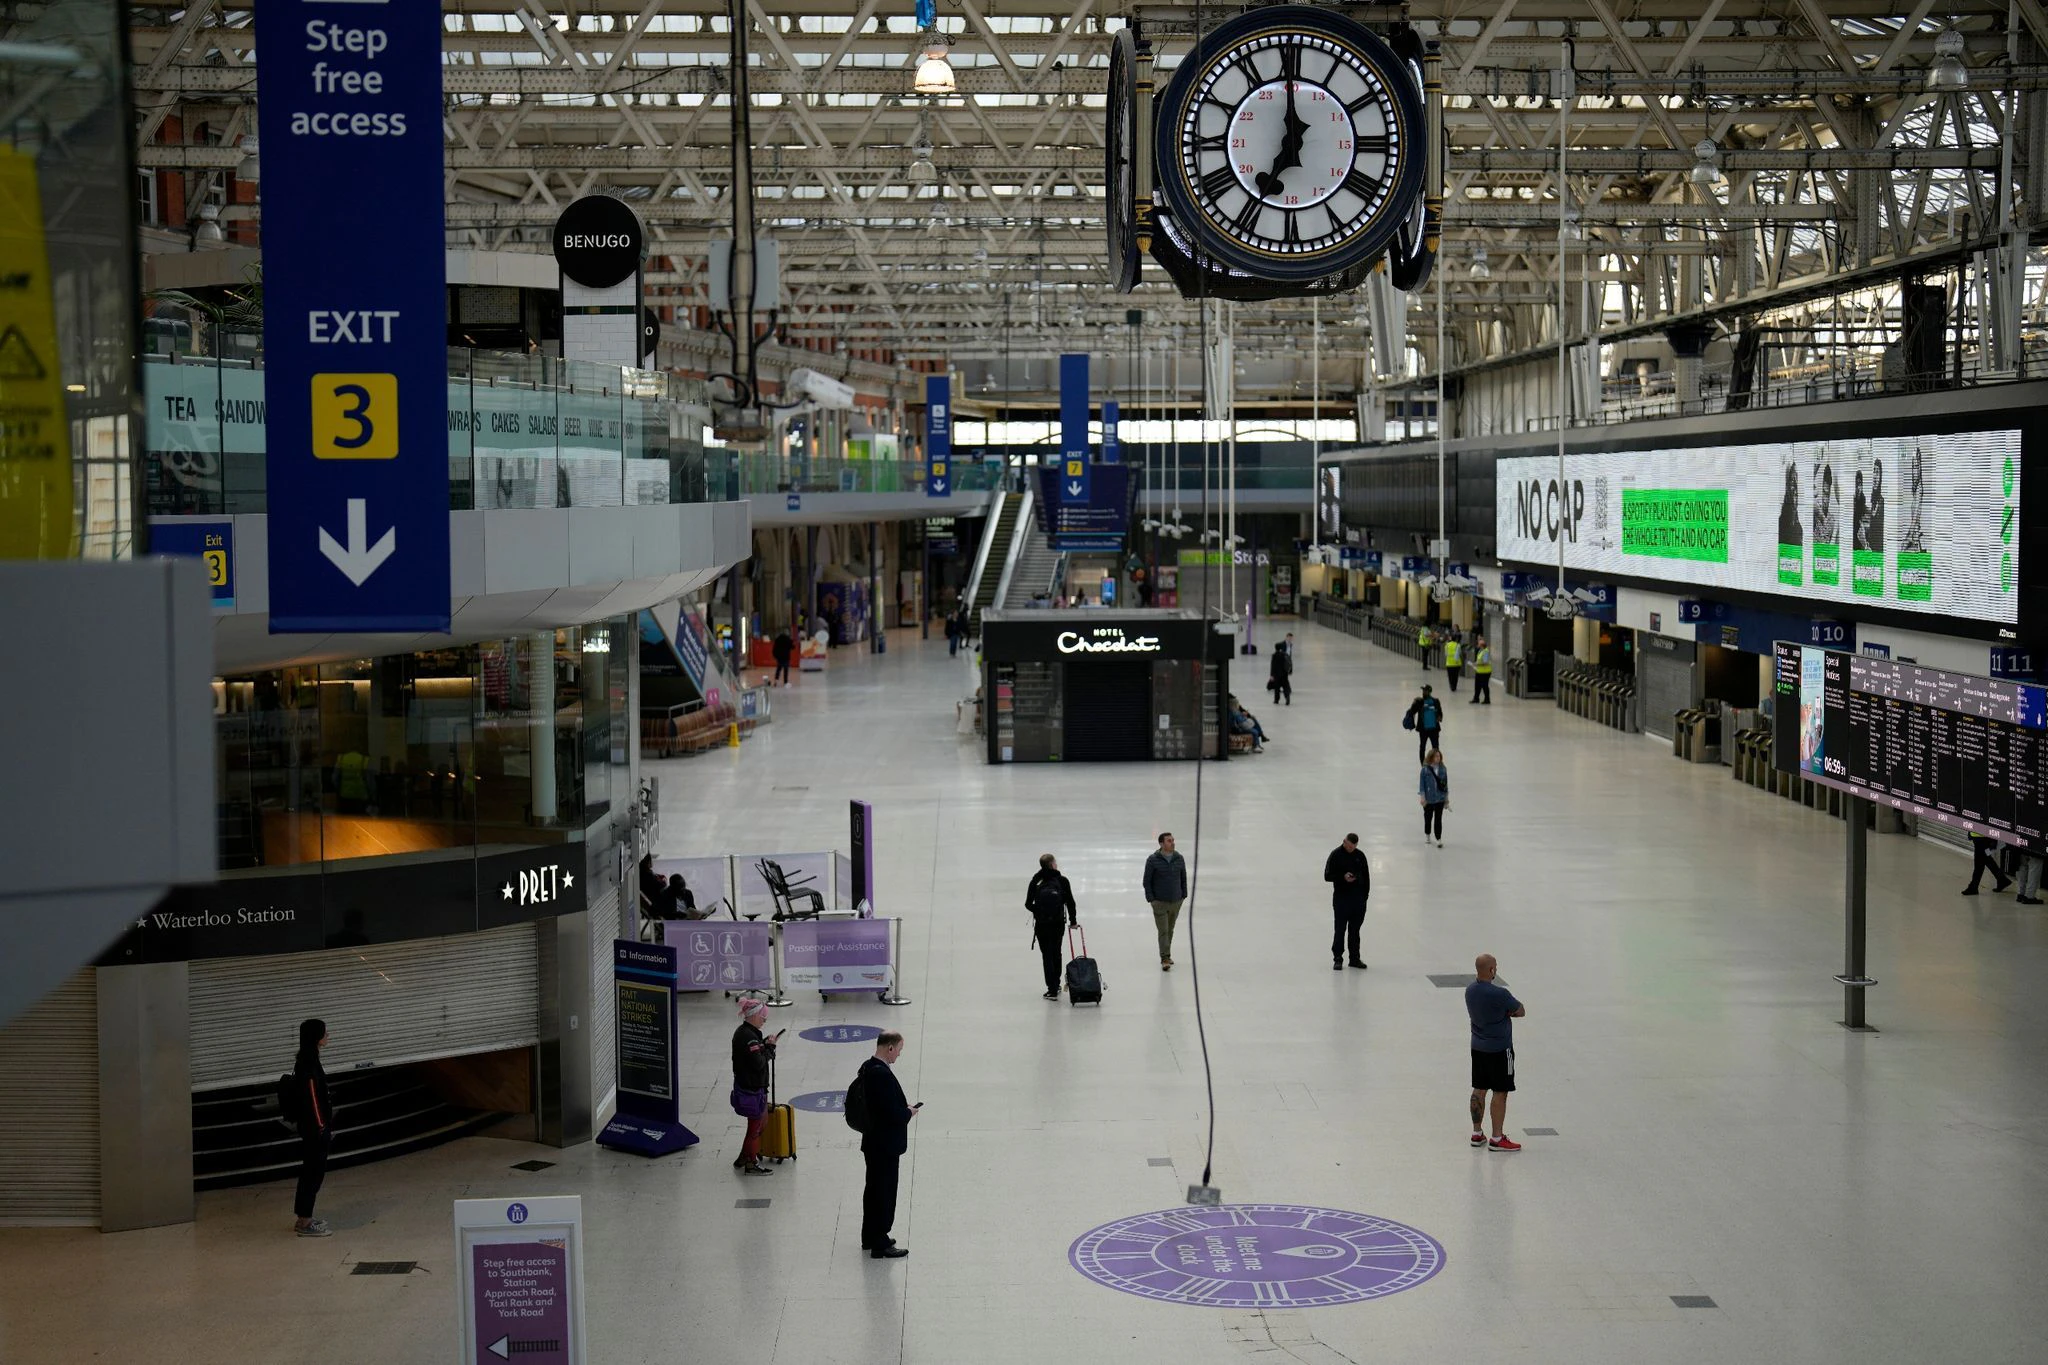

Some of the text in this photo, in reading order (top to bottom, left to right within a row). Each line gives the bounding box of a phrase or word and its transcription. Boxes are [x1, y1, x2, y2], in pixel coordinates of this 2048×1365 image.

[306, 19, 388, 59] Step
[312, 62, 383, 95] free
[1258, 91, 1273, 101] 23
[1311, 92, 1326, 101] 13
[1239, 112, 1254, 121] 22
[1331, 112, 1344, 122] 14
[291, 111, 407, 137] access
[1232, 138, 1247, 148] 21
[1338, 140, 1352, 150] 15
[1238, 164, 1254, 175] 20
[1329, 167, 1344, 178] 16
[1312, 187, 1326, 197] 17
[1283, 195, 1299, 205] 18
[563, 234, 631, 249] BENUGO
[309, 310, 399, 345] EXIT
[164, 396, 197, 421] TEA
[491, 413, 520, 433] CAKES
[528, 415, 557, 436] SALADS
[564, 417, 582, 437] BEER
[332, 384, 374, 448] 3
[1071, 462, 1079, 474] 7
[1517, 478, 1585, 543] NO CAP
[1684, 500, 1709, 521] GIVING
[1710, 500, 1726, 522] YOU
[927, 517, 955, 526] LUSH
[205, 533, 223, 547] Exit
[1659, 528, 1680, 547] TRUTH
[1681, 529, 1696, 548] AND
[1697, 529, 1708, 549] NO
[1370, 552, 1377, 561] 4
[208, 555, 221, 582] 3
[1408, 559, 1415, 568] 5
[1509, 575, 1516, 586] 7
[1599, 589, 1606, 601] 8
[1691, 604, 1701, 618] 9
[1093, 628, 1124, 637] HOTEL
[1811, 626, 1820, 641] 10
[1823, 627, 1844, 642] 10
[1991, 654, 2002, 672] 11
[2008, 654, 2034, 672] 11
[519, 864, 559, 906] PRET
[152, 906, 296, 930] Waterloo Station
[788, 942, 885, 954] Passenger Assistance
[629, 951, 667, 964] Information
[621, 989, 637, 999] RMT
[621, 1001, 657, 1013] NATIONAL
[621, 1010, 652, 1024] STRIKES
[1176, 1244, 1206, 1265] clock
[1203, 1235, 1238, 1273] under the
[1234, 1236, 1263, 1271] Meet me
[483, 1258, 556, 1268] Step free access
[500, 1268, 552, 1277] Southbank,
[503, 1279, 537, 1288] Station
[484, 1288, 557, 1298] Approach Road,
[489, 1298, 553, 1308] Taxi Rank and
[498, 1308, 544, 1317] York Road
